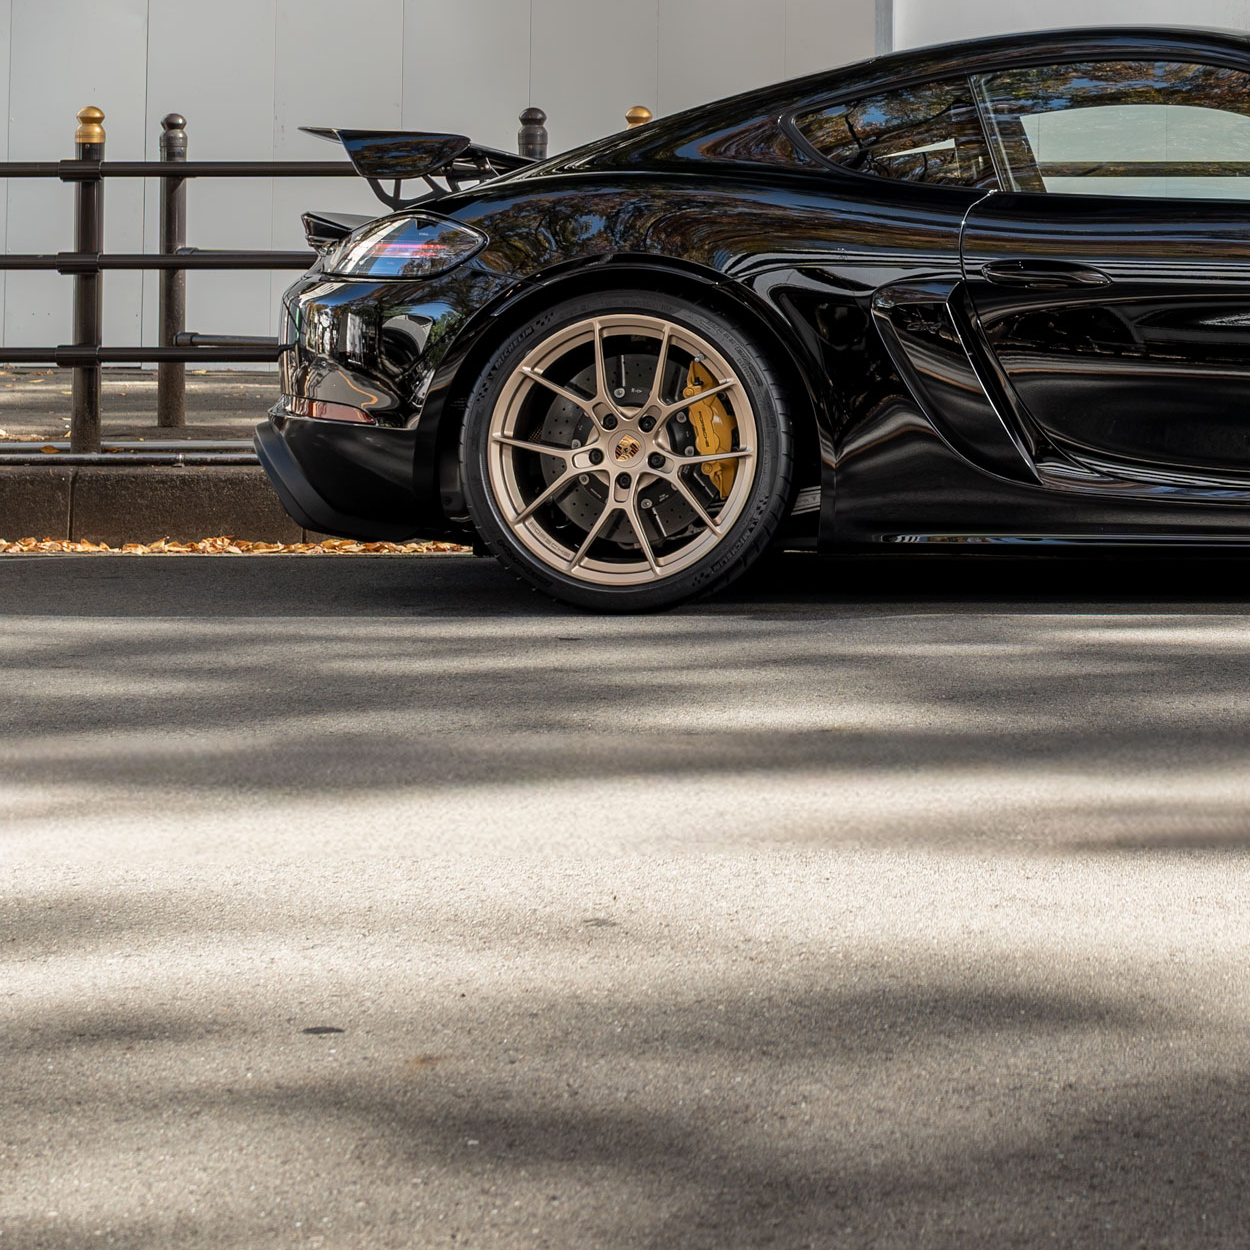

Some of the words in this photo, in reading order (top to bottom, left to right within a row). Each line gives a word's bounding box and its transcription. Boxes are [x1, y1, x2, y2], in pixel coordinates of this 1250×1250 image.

[494, 325, 534, 369] MICHELIN
[698, 410, 710, 447] PORSCHE
[711, 528, 751, 572] MICHELIN
